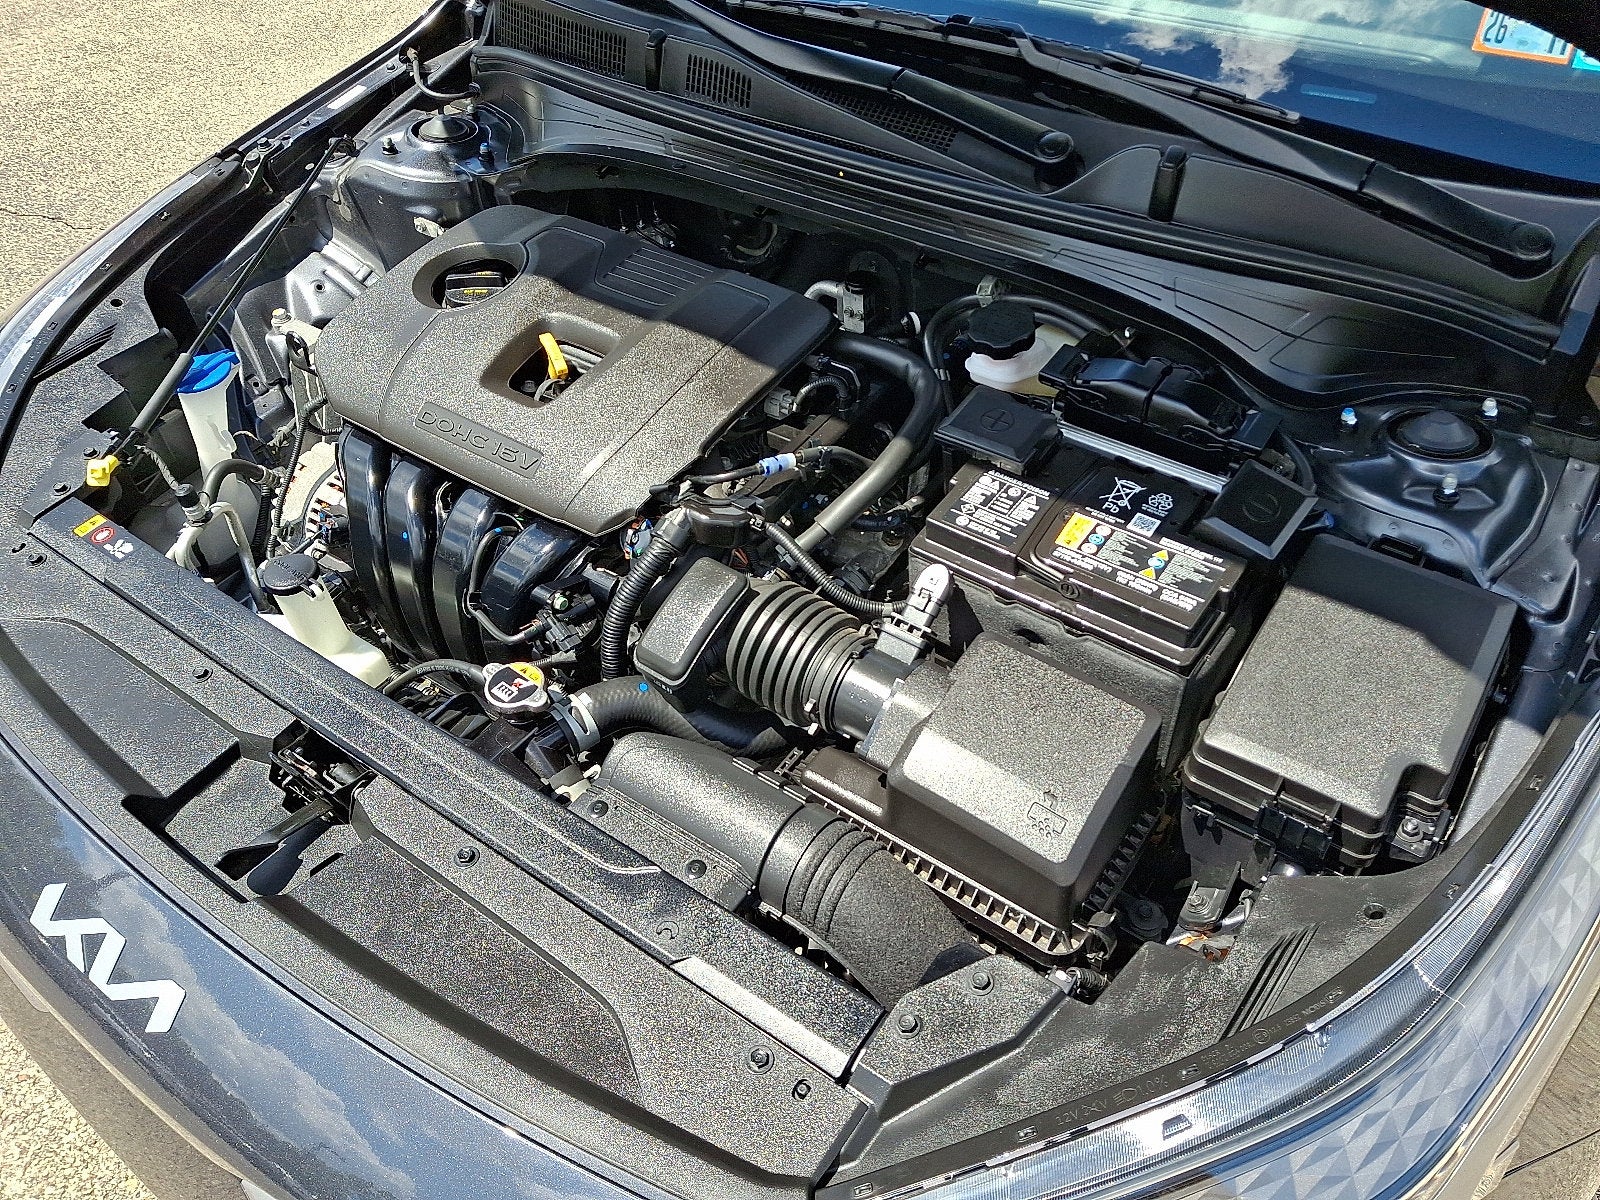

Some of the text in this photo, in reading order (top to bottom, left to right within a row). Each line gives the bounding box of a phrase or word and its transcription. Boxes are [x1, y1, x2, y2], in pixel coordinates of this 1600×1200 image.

[417, 410, 539, 471] DOHC 16V
[1102, 502, 1120, 513] Pb
[29, 882, 187, 1033] KIA
